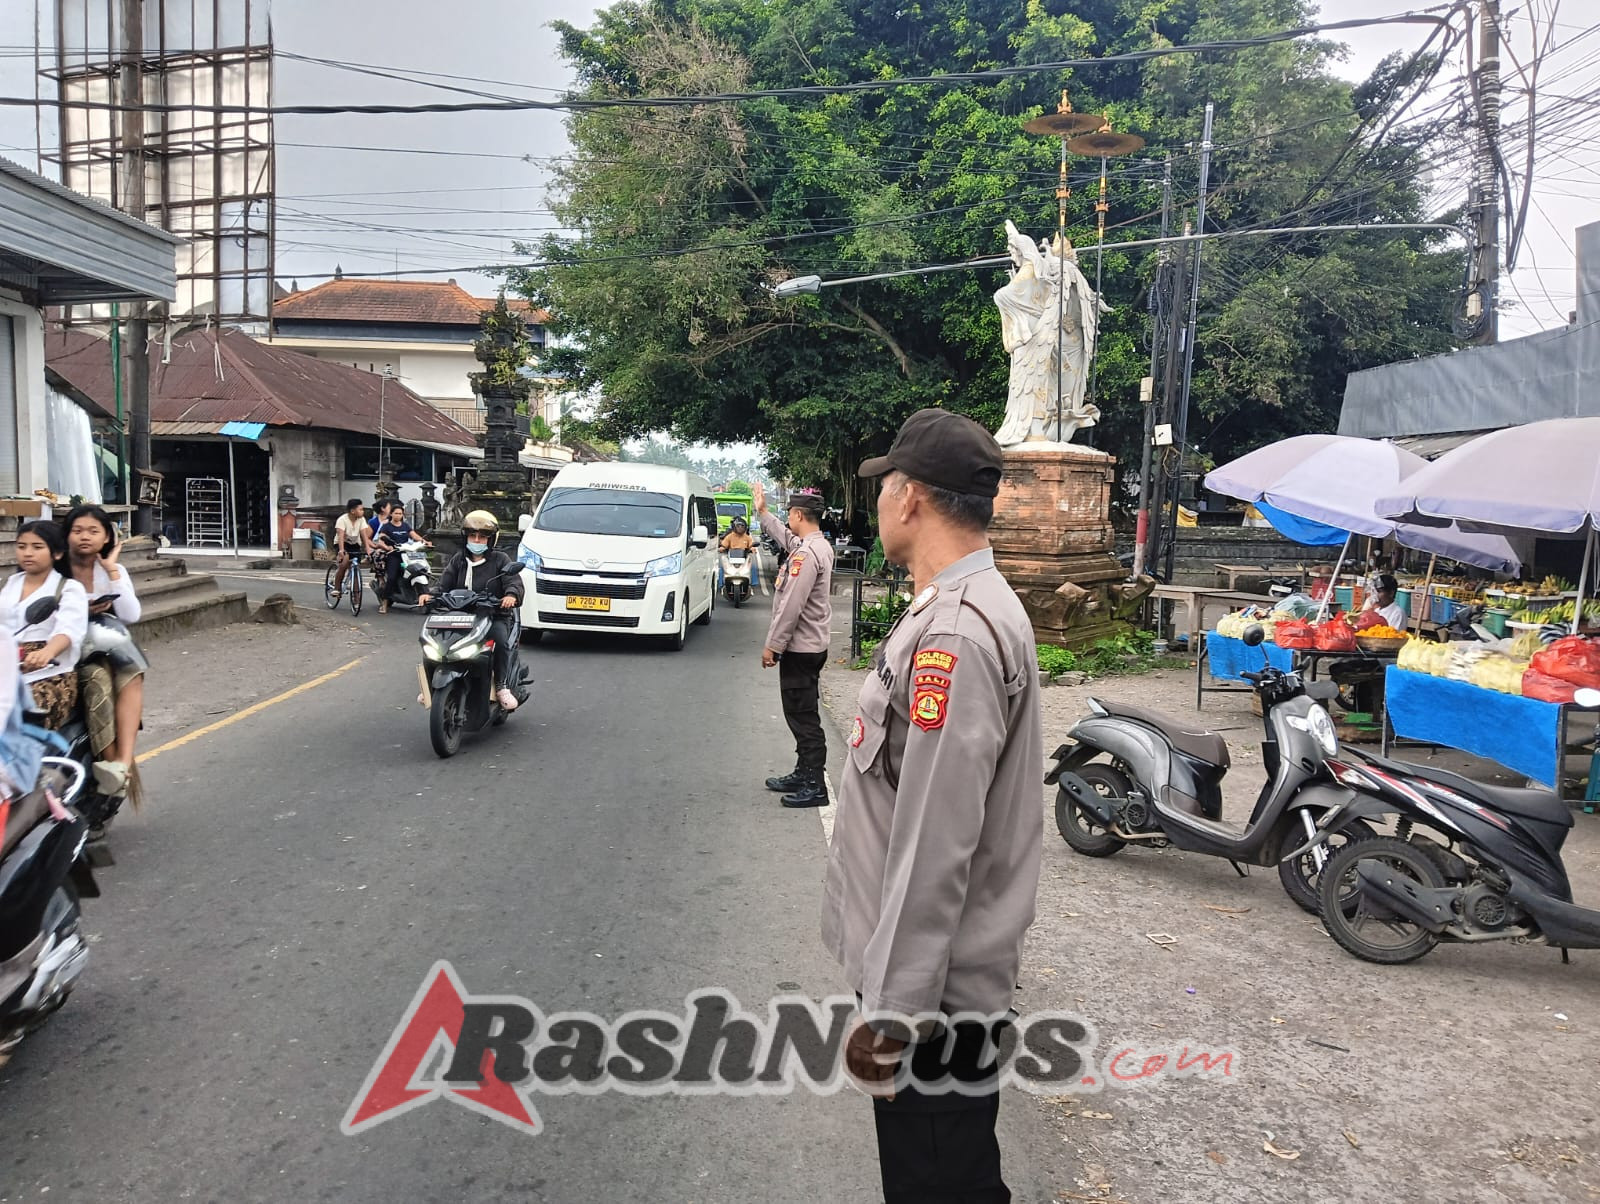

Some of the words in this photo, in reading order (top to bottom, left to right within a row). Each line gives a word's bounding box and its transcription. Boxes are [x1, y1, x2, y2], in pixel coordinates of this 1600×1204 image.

[588, 482, 647, 491] PARIWISATA
[916, 652, 952, 663] POLRES
[918, 676, 945, 685] BALI
